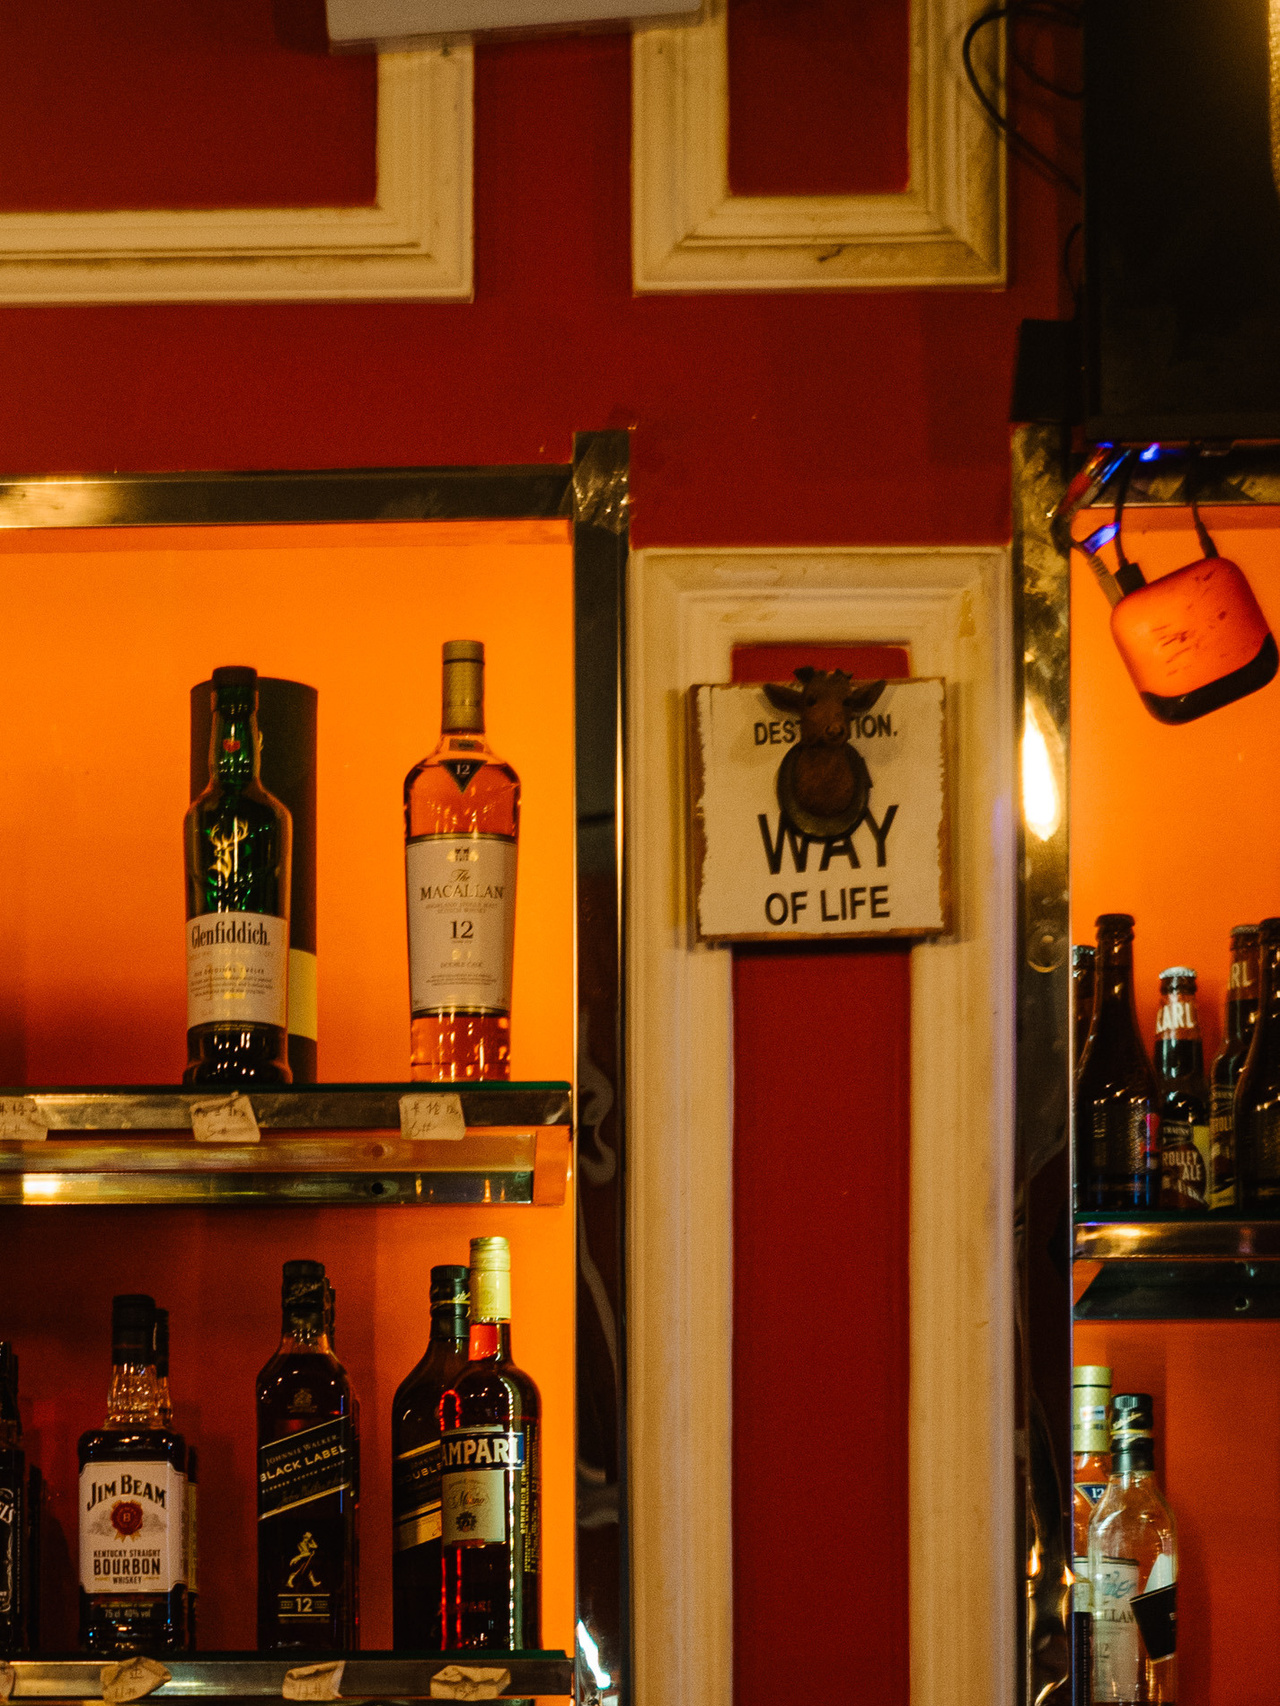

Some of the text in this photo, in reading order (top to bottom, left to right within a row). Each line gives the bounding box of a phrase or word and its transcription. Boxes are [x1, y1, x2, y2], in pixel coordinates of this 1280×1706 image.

[754, 714, 898, 745] DESION.
[456, 764, 470, 775] 12
[757, 805, 899, 875] WAY
[420, 884, 504, 900] MACALLAN
[765, 886, 890, 925] OF LIFE
[191, 920, 269, 949] Glenfiddich
[450, 921, 474, 939] 12
[1162, 1150, 1198, 1167] ROLLEY
[441, 1438, 520, 1466] AMPARI
[260, 1444, 346, 1483] BLACK LABEL
[87, 1473, 167, 1511] JIM BEAM
[93, 1549, 161, 1558] KENTUCKY STRAIGHT
[93, 1558, 161, 1576] BOURBON
[112, 1576, 142, 1585] WHISKEY
[295, 1597, 312, 1612] 12
